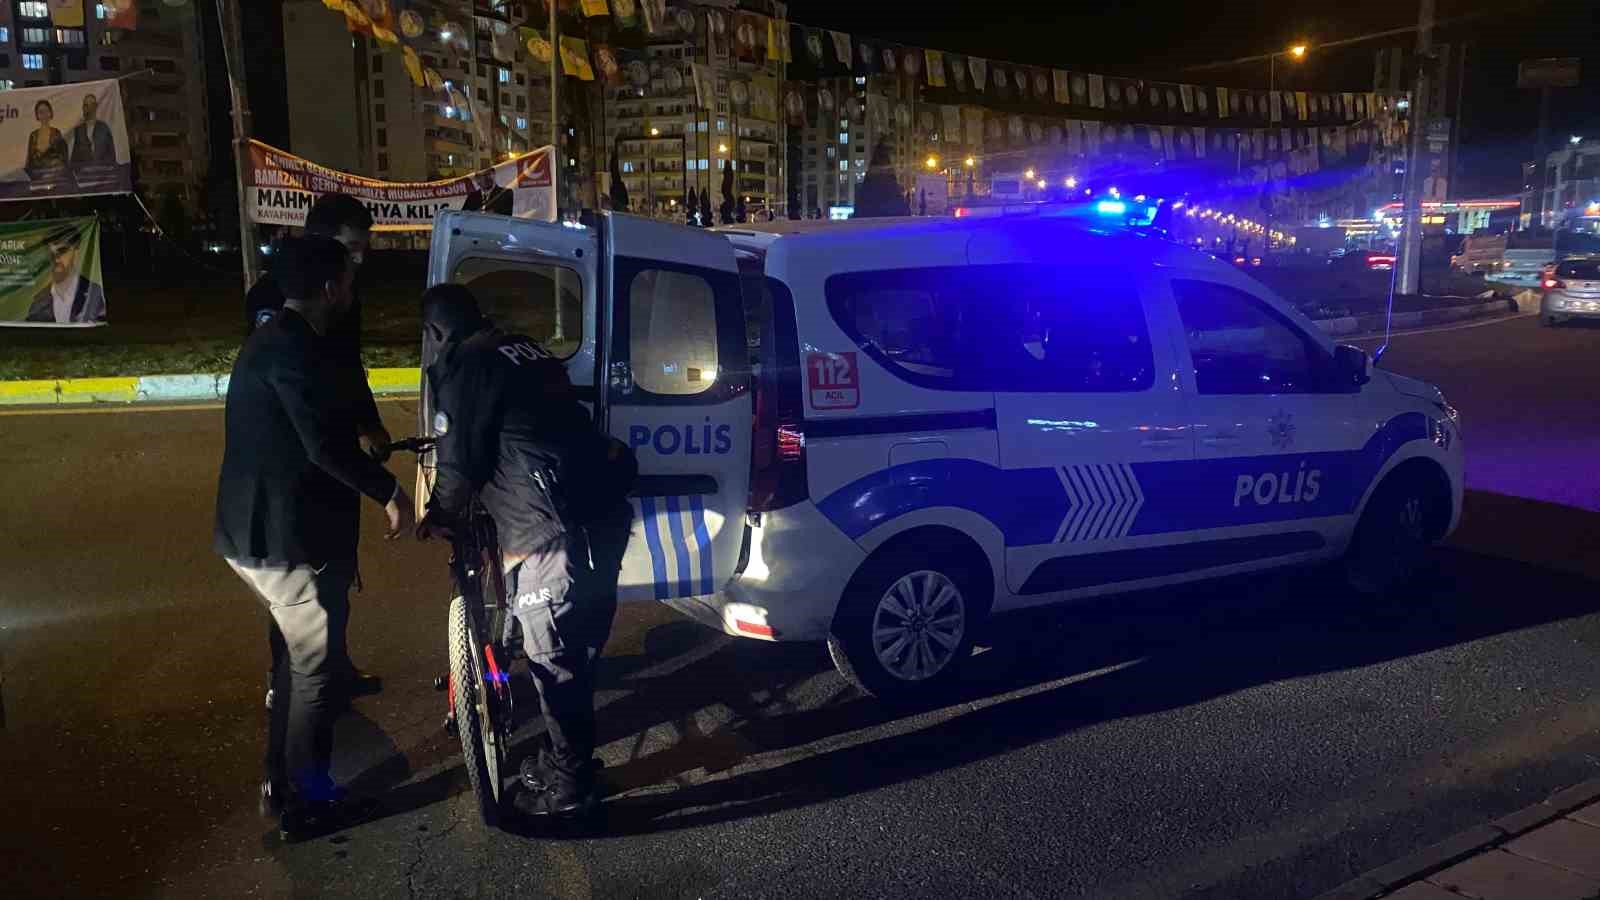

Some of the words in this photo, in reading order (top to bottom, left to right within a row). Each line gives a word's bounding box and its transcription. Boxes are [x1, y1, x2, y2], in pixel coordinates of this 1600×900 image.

[814, 357, 851, 385] 112
[629, 415, 732, 455] POLİS
[1233, 460, 1321, 507] POLİS
